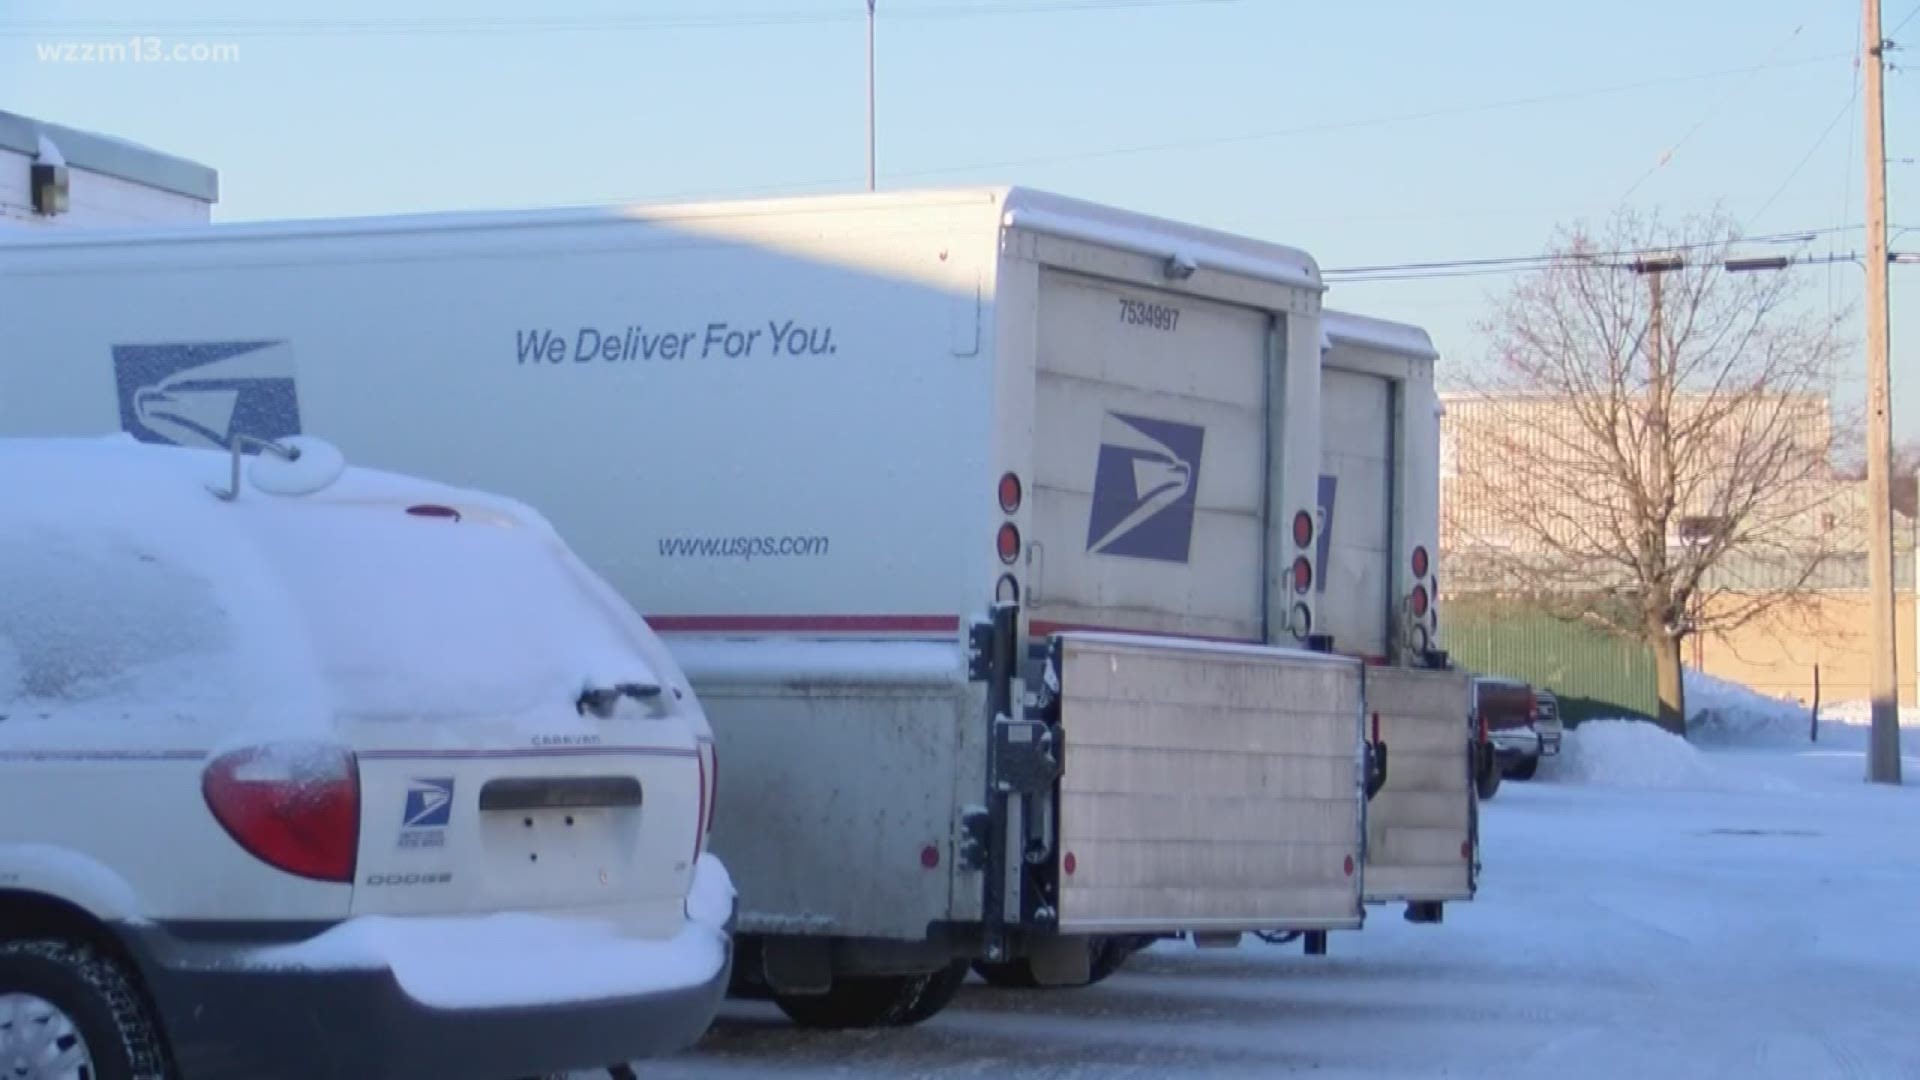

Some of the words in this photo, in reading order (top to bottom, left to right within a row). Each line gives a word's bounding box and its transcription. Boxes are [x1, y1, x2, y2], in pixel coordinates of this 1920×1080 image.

[1119, 298, 1179, 331] 7534997
[516, 328, 566, 364] We
[574, 325, 696, 362] Deliver
[702, 323, 761, 358] For
[769, 320, 836, 356] You.
[659, 536, 829, 560] www.usps.com
[366, 874, 453, 886] DODGE
